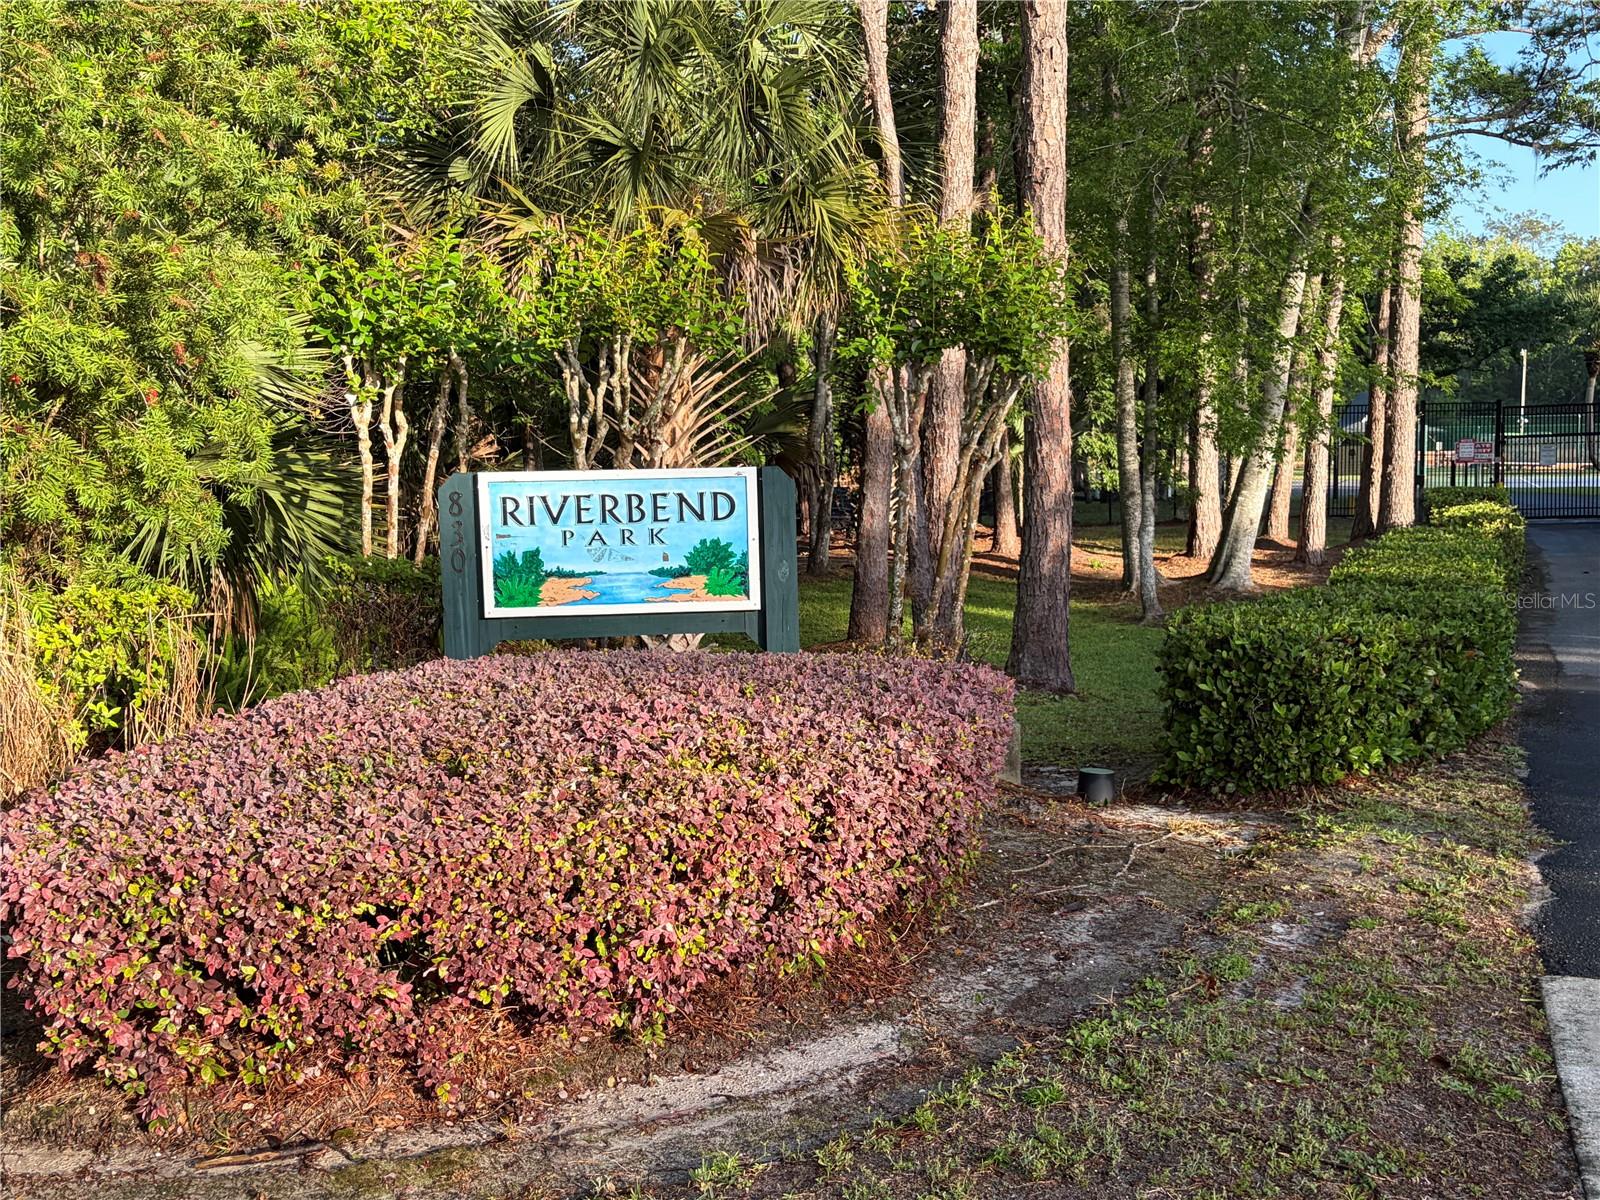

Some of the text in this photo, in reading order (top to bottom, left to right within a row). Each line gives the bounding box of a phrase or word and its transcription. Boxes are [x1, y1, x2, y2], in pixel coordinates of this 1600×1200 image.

[500, 491, 737, 528] RIVERBEND
[448, 491, 466, 574] 830
[561, 527, 670, 548] PARK
